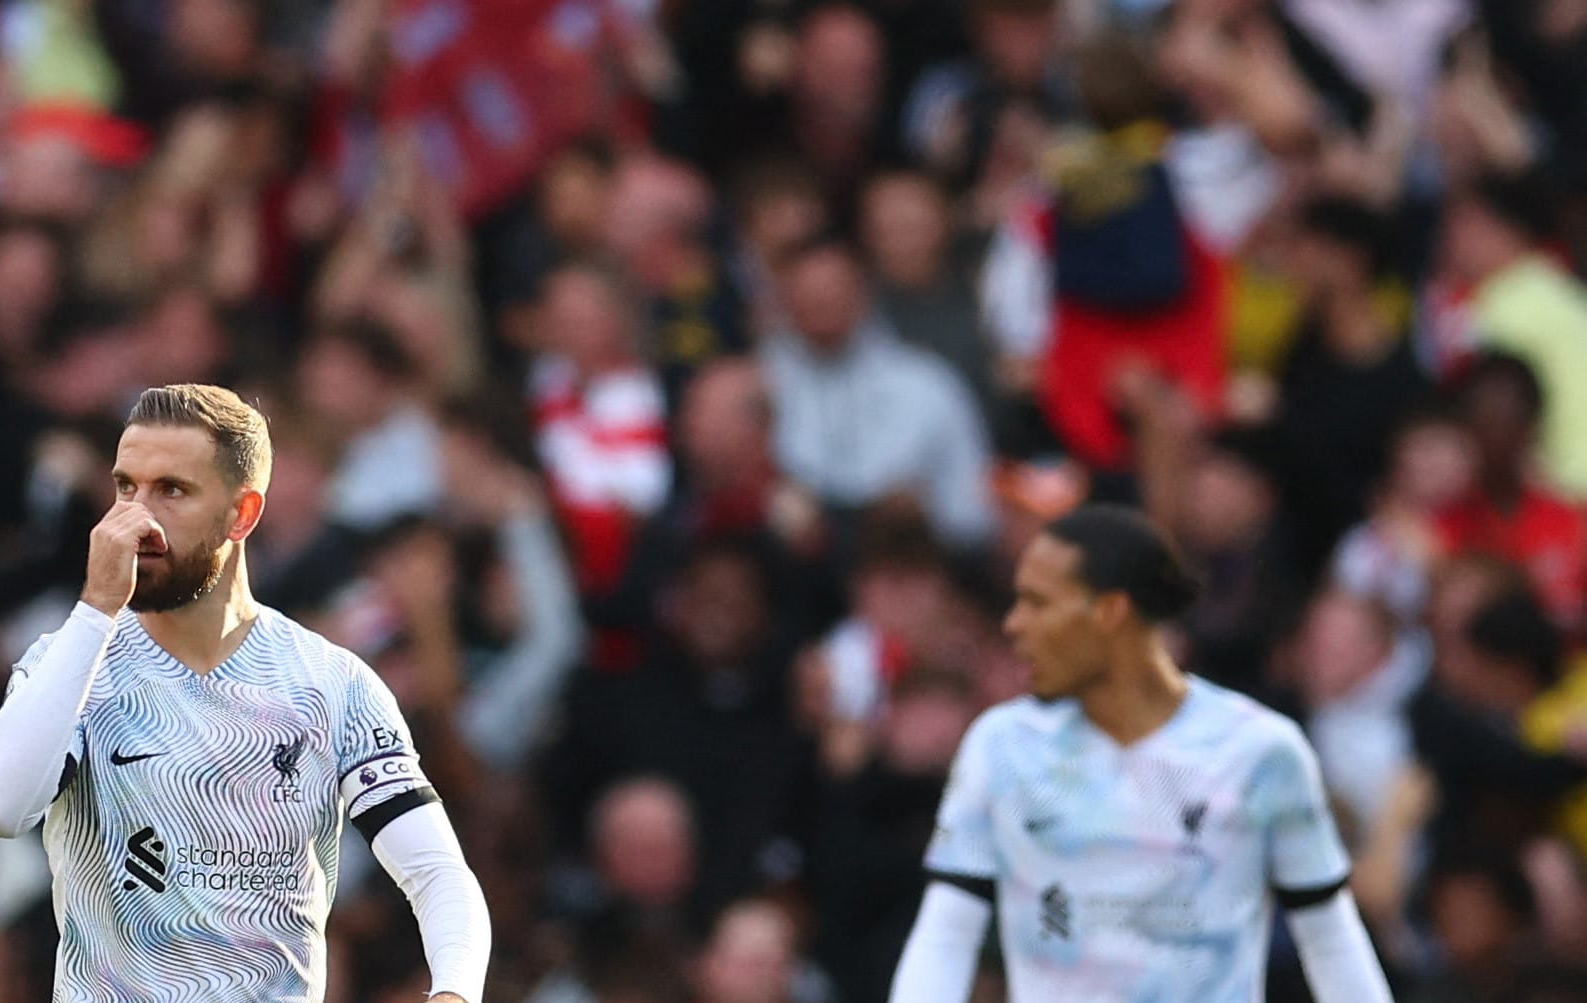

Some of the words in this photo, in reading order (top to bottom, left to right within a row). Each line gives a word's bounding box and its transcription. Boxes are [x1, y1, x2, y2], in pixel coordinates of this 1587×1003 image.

[272, 789, 302, 803] LFC
[177, 844, 295, 868] standard
[176, 868, 300, 891] chartered
